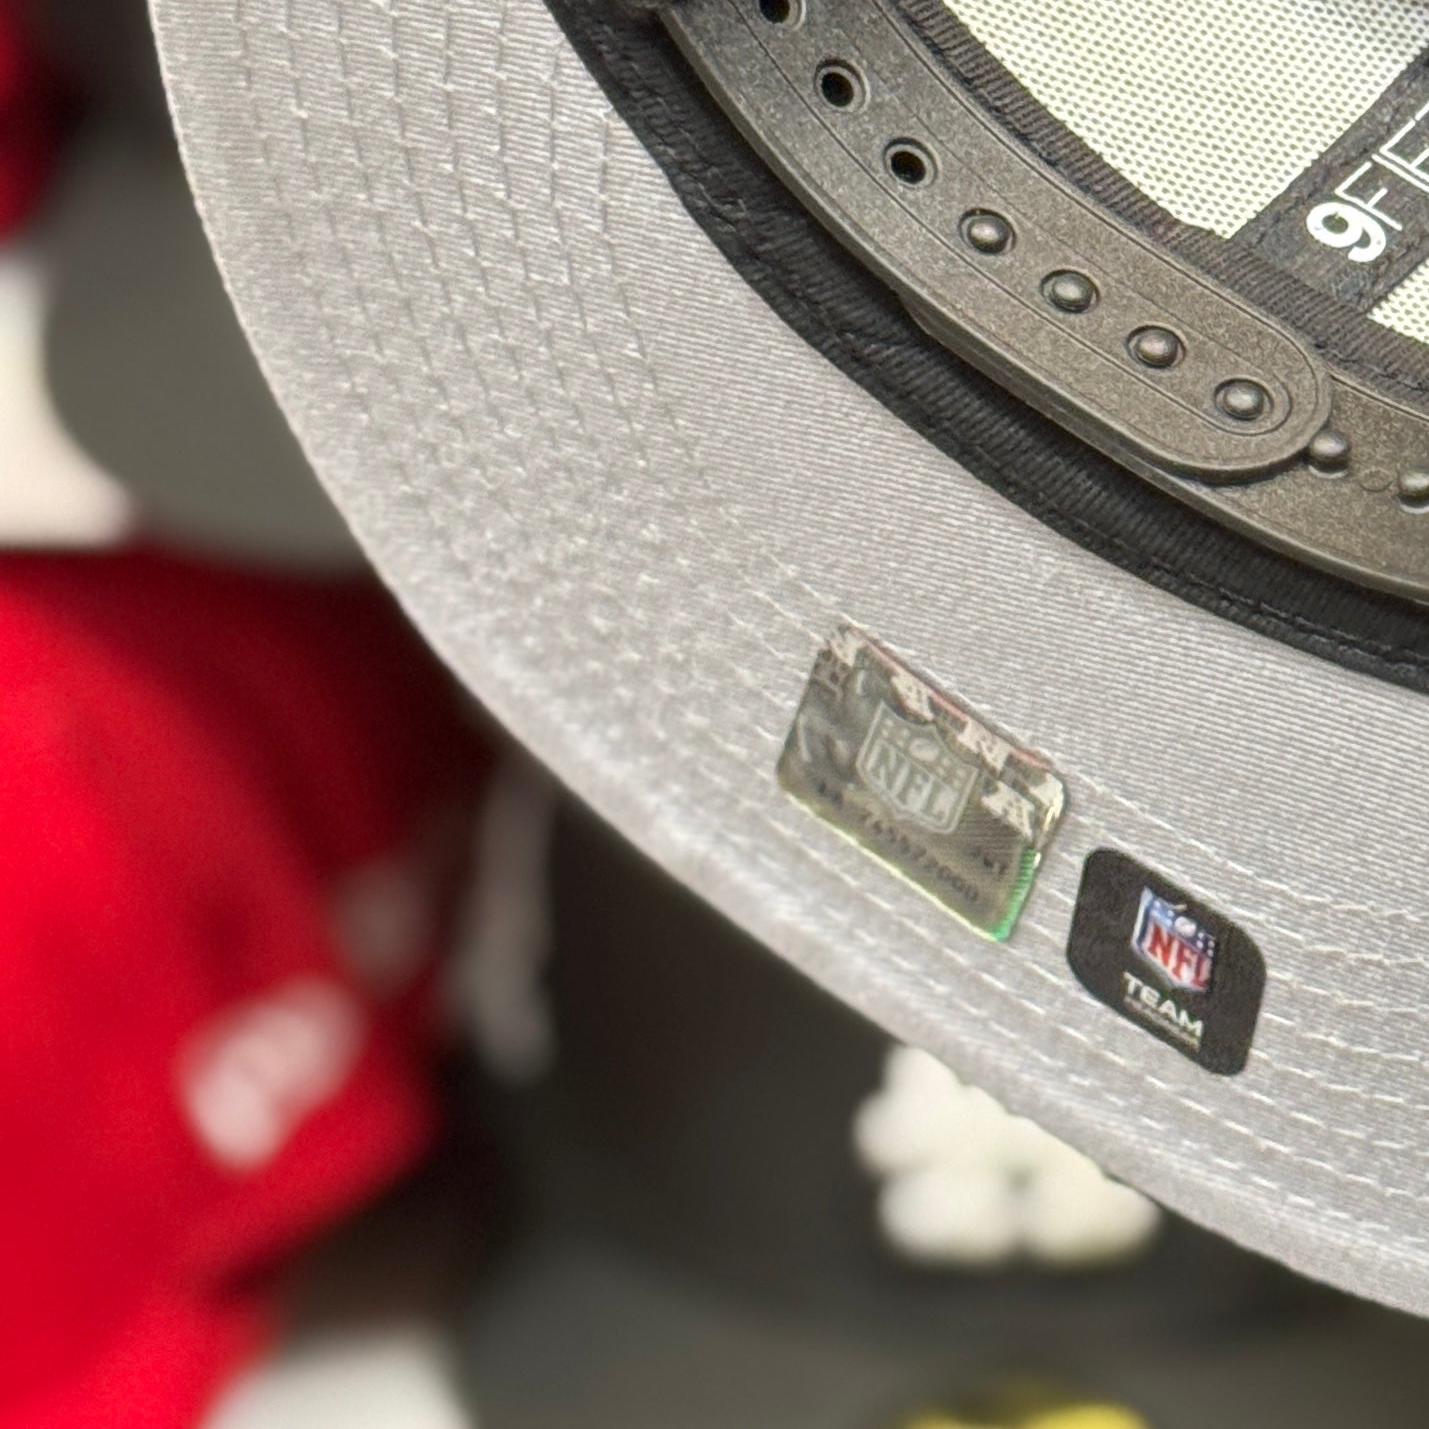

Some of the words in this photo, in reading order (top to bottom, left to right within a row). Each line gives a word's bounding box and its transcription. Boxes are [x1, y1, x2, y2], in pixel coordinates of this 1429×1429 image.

[868, 738, 961, 825] NFL
[1148, 921, 1208, 989] NFL
[1123, 971, 1204, 1037] TEAM
